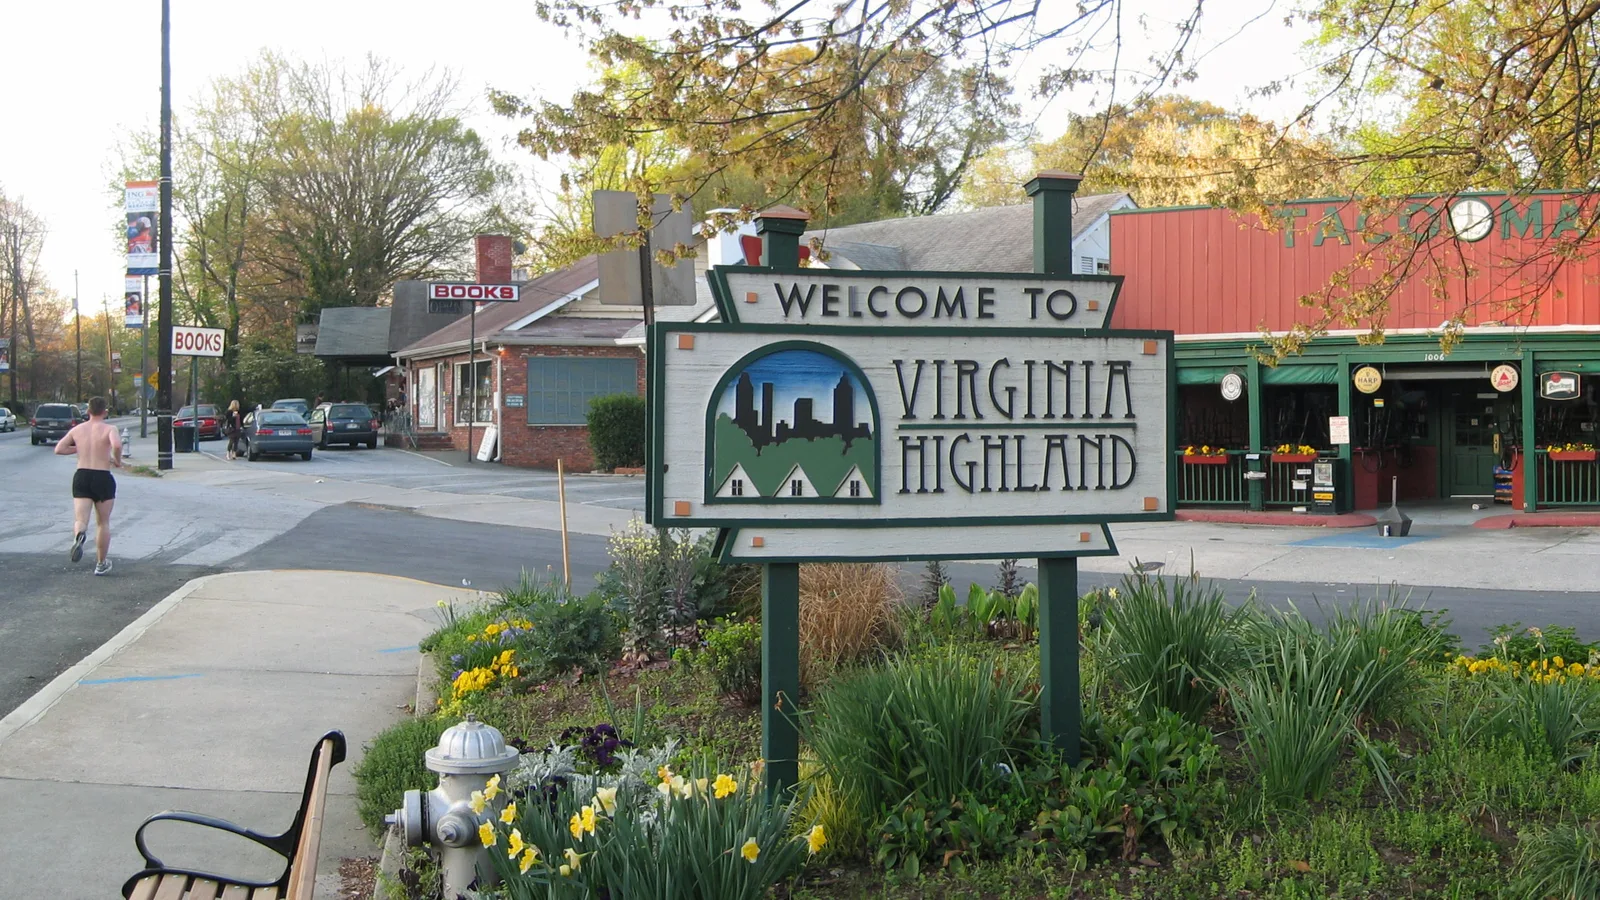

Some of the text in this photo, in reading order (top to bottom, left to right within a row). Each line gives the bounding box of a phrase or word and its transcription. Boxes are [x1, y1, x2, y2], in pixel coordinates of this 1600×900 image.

[1272, 199, 1600, 248] TACO MA
[435, 285, 514, 299] BOOKS
[774, 283, 1078, 321] WELCOME TO
[175, 332, 222, 352] BOOKS
[1424, 353, 1445, 361] 1006
[892, 357, 1136, 420] VIRGINIA
[898, 433, 1138, 495] HIGHLAND
